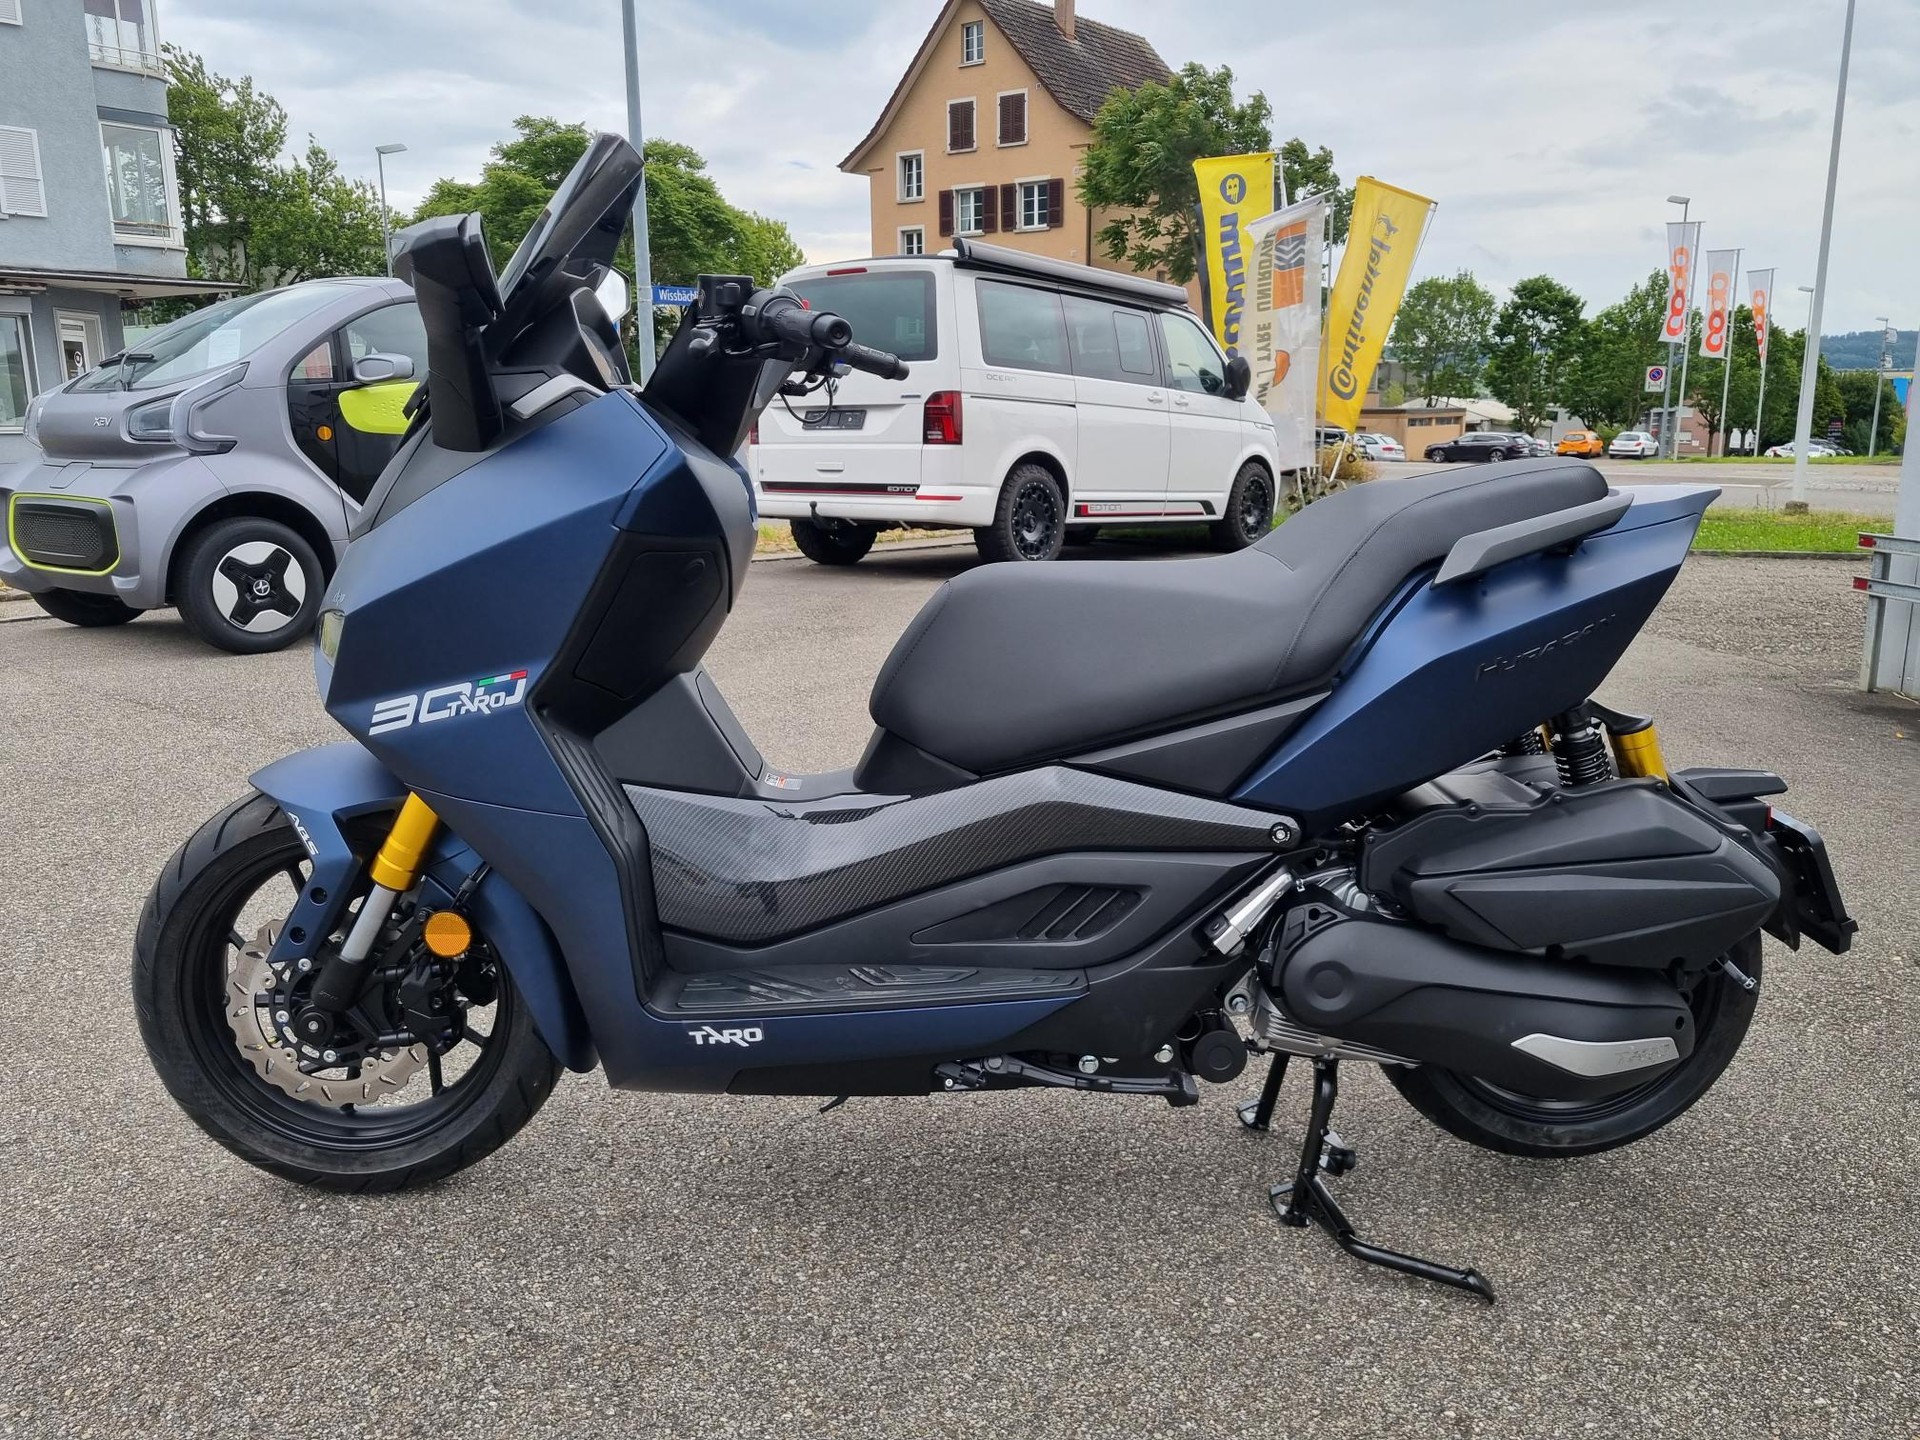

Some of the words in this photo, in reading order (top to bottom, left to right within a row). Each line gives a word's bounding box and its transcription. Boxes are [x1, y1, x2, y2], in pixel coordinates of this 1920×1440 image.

[93, 416, 112, 427] XEV
[887, 485, 918, 493] EDITION
[1089, 503, 1122, 512] EDITION
[447, 691, 506, 715] TARO
[287, 811, 320, 855] ABS
[688, 1025, 763, 1048] TARO
